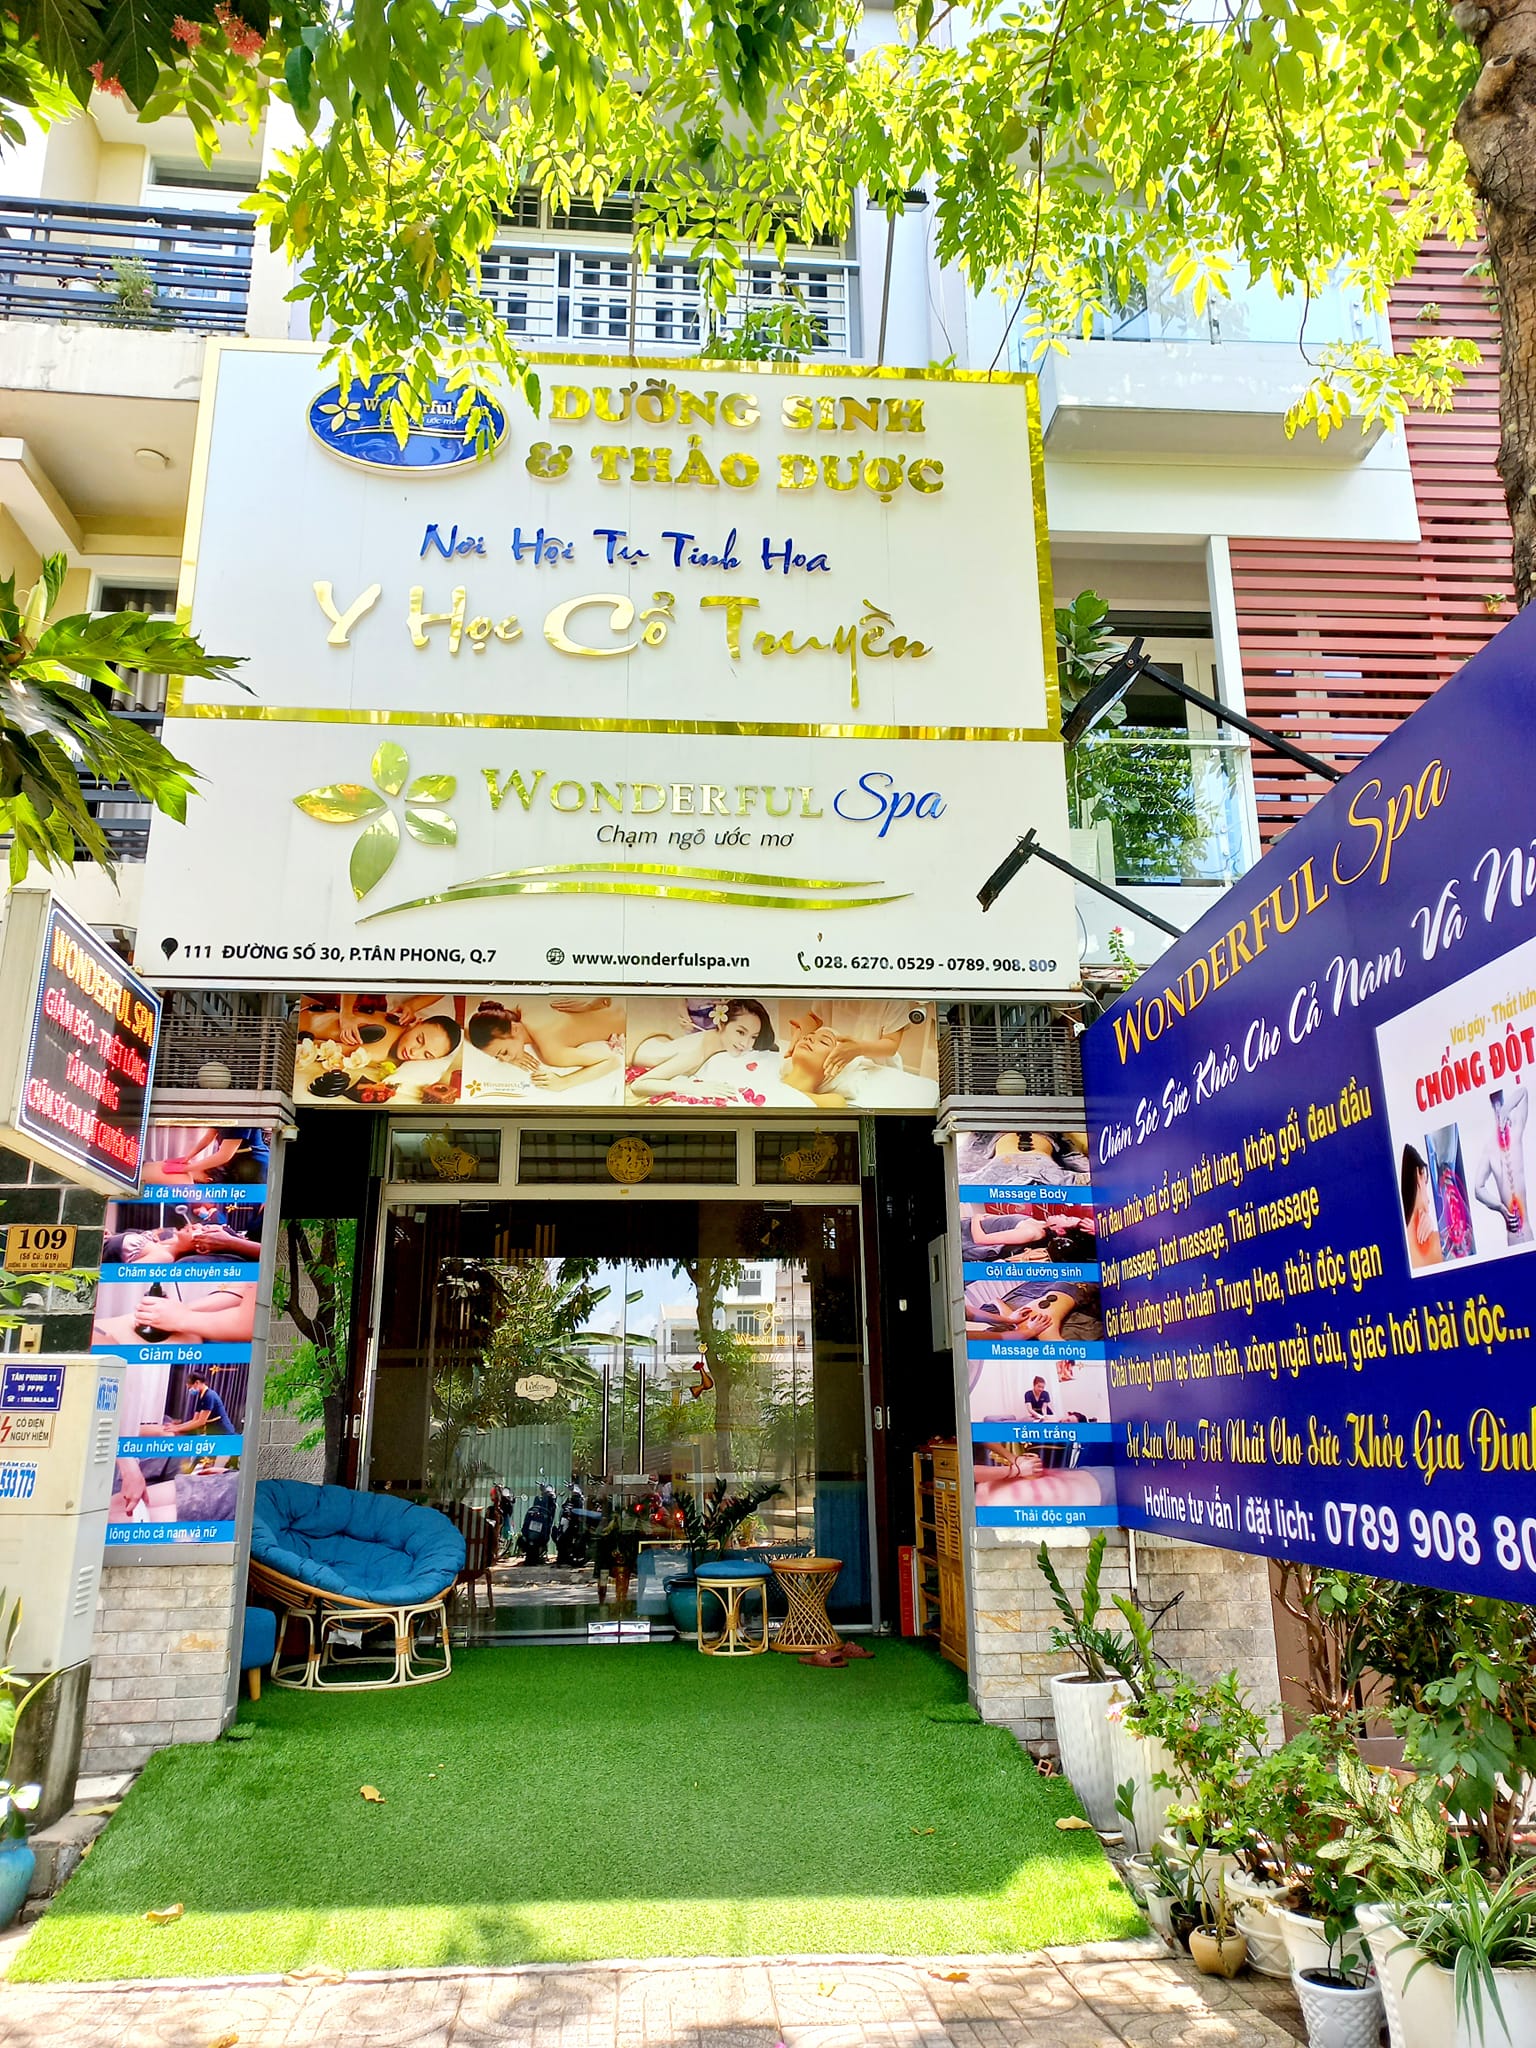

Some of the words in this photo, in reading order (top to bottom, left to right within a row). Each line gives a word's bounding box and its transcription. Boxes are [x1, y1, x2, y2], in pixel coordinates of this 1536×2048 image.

[548, 378, 761, 428] DƯỠNG
[781, 394, 927, 434] SINH
[525, 441, 573, 480] &
[590, 434, 760, 488] THẢO
[777, 450, 945, 503] DƯỢC
[419, 523, 487, 561] Nơi
[512, 527, 576, 566] Hội
[593, 529, 649, 567] Tụ
[661, 527, 742, 570] Tinh
[761, 537, 832, 576] Hoa
[313, 580, 383, 645] Y
[405, 584, 524, 654] Học
[543, 591, 677, 657] Cổ
[700, 596, 935, 709] Truyền
[480, 768, 824, 818] WONDERFUL
[833, 772, 948, 837] Spa
[596, 825, 658, 848] Chạm
[714, 826, 752, 846] ước
[760, 832, 795, 847] mơ
[1112, 855, 1329, 1066] WONDERFUL
[1331, 758, 1451, 886] Spa
[183, 944, 212, 959] 111
[221, 942, 289, 960] ĐƯỜNG
[292, 942, 316, 960] SỐ
[320, 946, 345, 963] 30,
[349, 944, 397, 962] P.TÂN
[400, 948, 466, 965] PHONG,
[470, 949, 497, 965] Q.7
[572, 949, 751, 969] www.wonderfulspa.vn
[897, 956, 935, 972] 0529
[1029, 957, 1058, 973] 809
[52, 925, 131, 1029] WONDERFUL
[132, 1001, 154, 1047] SPA
[1099, 1121, 1133, 1165] Chăm
[1135, 1097, 1160, 1144] Sóc
[1162, 1077, 1191, 1128] Sức
[1192, 1043, 1239, 1105] Khỏe
[1243, 1017, 1281, 1073] Cho
[1288, 981, 1323, 1044] Cả
[1325, 946, 1407, 1017] Nam
[1411, 878, 1468, 961] Và
[1449, 1021, 1466, 1046] Vai
[1415, 1046, 1487, 1113] CHỐNG
[1488, 1022, 1535, 1085] ĐỘT
[1097, 1210, 1110, 1243] Trị
[1108, 1207, 1124, 1234] đau
[1123, 1193, 1144, 1228] nhức
[1144, 1185, 1158, 1218] vai
[1158, 1170, 1170, 1212] cổ
[1191, 1152, 1213, 1197] thắt
[1243, 1127, 1276, 1172] khớp
[1279, 1107, 1307, 1166] gối,
[1307, 1103, 1338, 1143] đau
[1339, 1076, 1373, 1128] đầu
[172, 1187, 202, 1200] thông
[205, 1187, 228, 1198] kinh
[231, 1187, 246, 1201] lạc
[989, 1188, 1037, 1201] Massage
[1040, 1188, 1068, 1201] Body
[18, 1228, 67, 1250] 109
[1101, 1257, 1120, 1291] Body
[1160, 1234, 1179, 1268] foot
[1179, 1222, 1229, 1260] massage,
[1228, 1201, 1257, 1243] Thái
[1258, 1186, 1320, 1230] massage
[118, 1265, 146, 1277] Chăm
[149, 1265, 167, 1277] sóc
[170, 1266, 182, 1277] da
[184, 1265, 221, 1279] chuyên
[223, 1265, 241, 1277] sâu
[986, 1265, 1003, 1279] Gội
[1005, 1263, 1024, 1277] đầu
[1026, 1265, 1059, 1279] dưỡng
[1061, 1265, 1082, 1277] sinh
[1105, 1307, 1120, 1342] Gội
[1163, 1290, 1184, 1324] sinh
[1184, 1273, 1217, 1320] chuẩn
[1216, 1278, 1253, 1316] Trung
[1253, 1266, 1285, 1305] Hoa,
[1285, 1249, 1315, 1296] thải
[1316, 1245, 1346, 1295] độc
[1350, 1243, 1383, 1292] gan
[139, 1347, 174, 1361] Giảm
[177, 1347, 203, 1361] béo
[991, 1344, 1040, 1357] Massage
[1042, 1344, 1056, 1356] đá
[1059, 1344, 1087, 1358] nóng
[1128, 1355, 1153, 1392] thông
[1152, 1351, 1173, 1383] kinh
[1173, 1349, 1189, 1388] lạc
[1189, 1344, 1213, 1379] toàn
[1245, 1335, 1278, 1380] xông
[1279, 1322, 1311, 1378] ngải
[1313, 1321, 1347, 1370] cứu,
[1350, 1314, 1387, 1372] giác
[1388, 1308, 1422, 1356] hơi
[1423, 1301, 1459, 1352] bài
[1463, 1294, 1531, 1355] độc...
[10, 1431, 31, 1441] NGUY
[1013, 1425, 1040, 1439] Tắm
[1043, 1425, 1077, 1441] trắng
[123, 1441, 143, 1453] đau
[146, 1440, 174, 1453] nhức
[177, 1440, 193, 1452] vai
[195, 1440, 216, 1454] gáy
[1165, 1419, 1196, 1469] Chọn
[1198, 1418, 1224, 1463] Tốt
[1226, 1418, 1268, 1464] Nhất
[1270, 1415, 1303, 1465] Cho
[1308, 1415, 1342, 1466] Sức
[1345, 1412, 1408, 1468] Khỏe
[1413, 1409, 1465, 1486] Gia
[1014, 1509, 1039, 1522] Thải
[1041, 1509, 1063, 1523] độc
[1066, 1511, 1087, 1523] gan
[109, 1527, 130, 1542] lông
[133, 1527, 151, 1539] cho
[167, 1530, 190, 1538] nam
[1144, 1485, 1186, 1522] Hotline
[1206, 1485, 1234, 1530] vấn
[1245, 1496, 1273, 1544] đặt
[1275, 1498, 1316, 1548] lịch:
[1324, 1500, 1400, 1554] 0789
[1409, 1508, 1481, 1566] 908
[1493, 1515, 1536, 1575] 80
